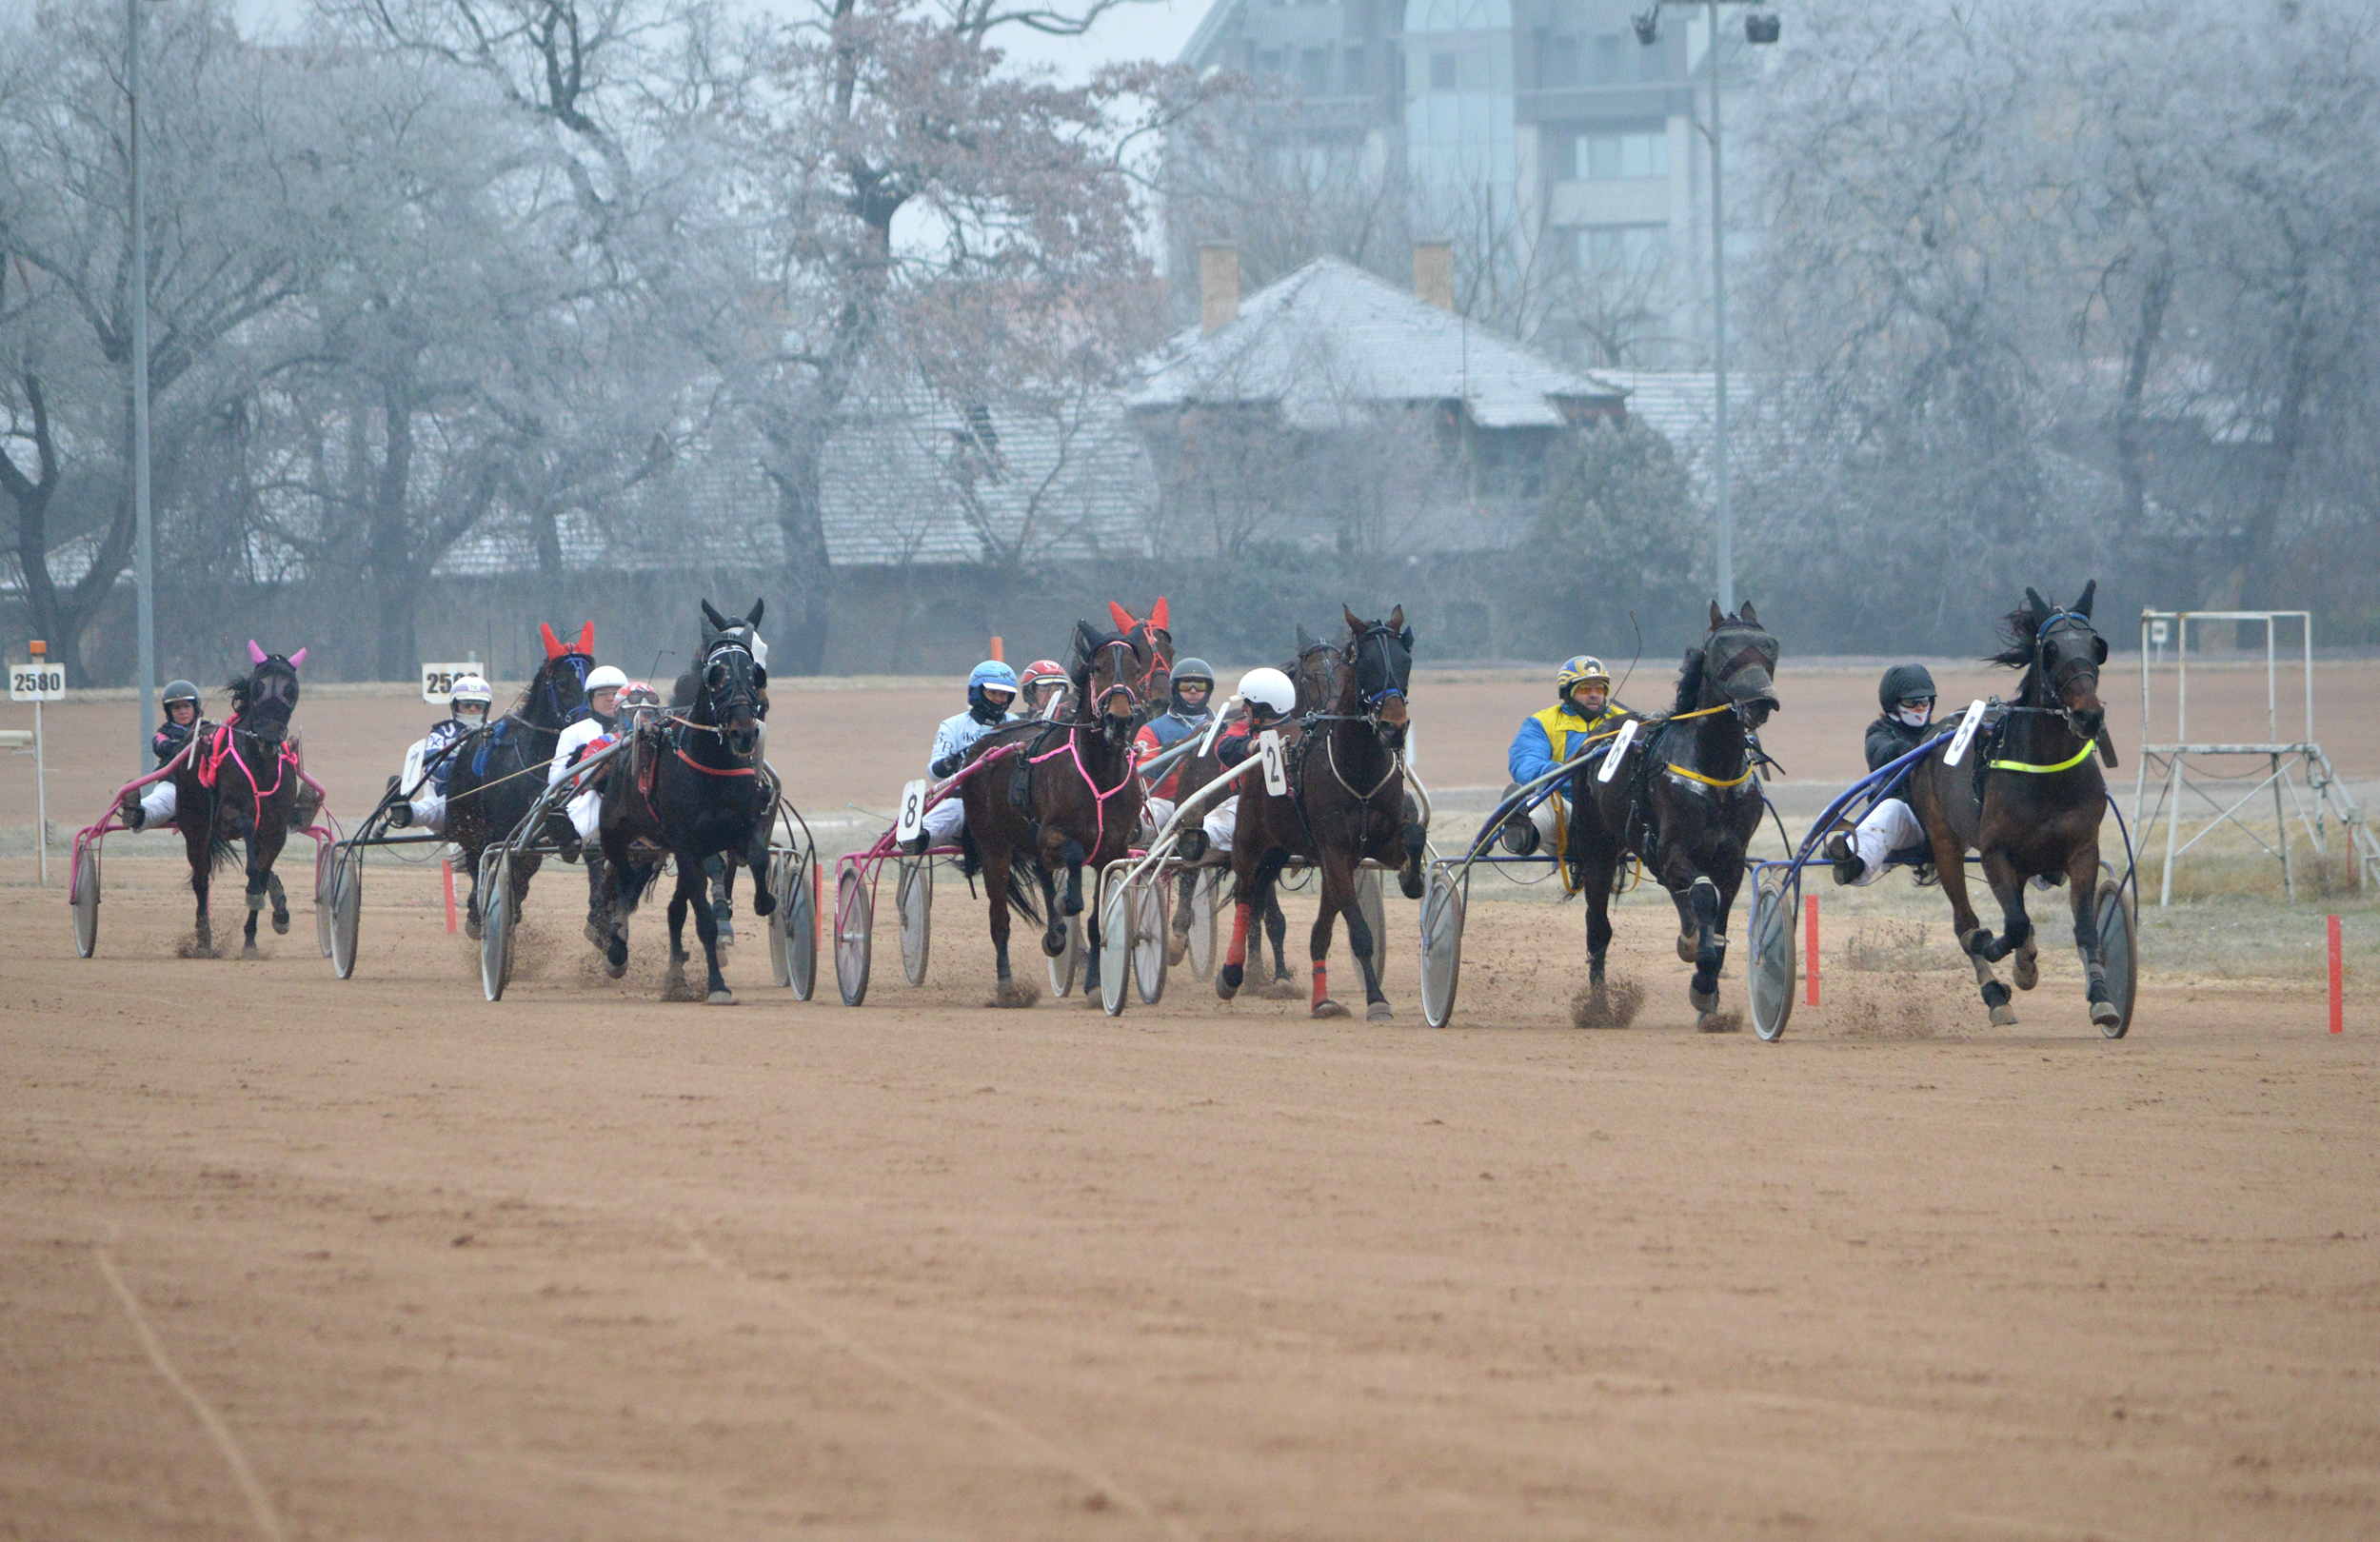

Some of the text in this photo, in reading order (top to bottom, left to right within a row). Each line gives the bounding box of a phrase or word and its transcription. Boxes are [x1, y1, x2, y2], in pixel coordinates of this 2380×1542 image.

[14, 672, 61, 692] 2580
[426, 672, 479, 694] 25
[1954, 716, 1975, 752] 5
[407, 751, 420, 783] 7
[1266, 745, 1280, 783] 2
[1607, 735, 1627, 769] 6
[904, 794, 918, 829] 8
